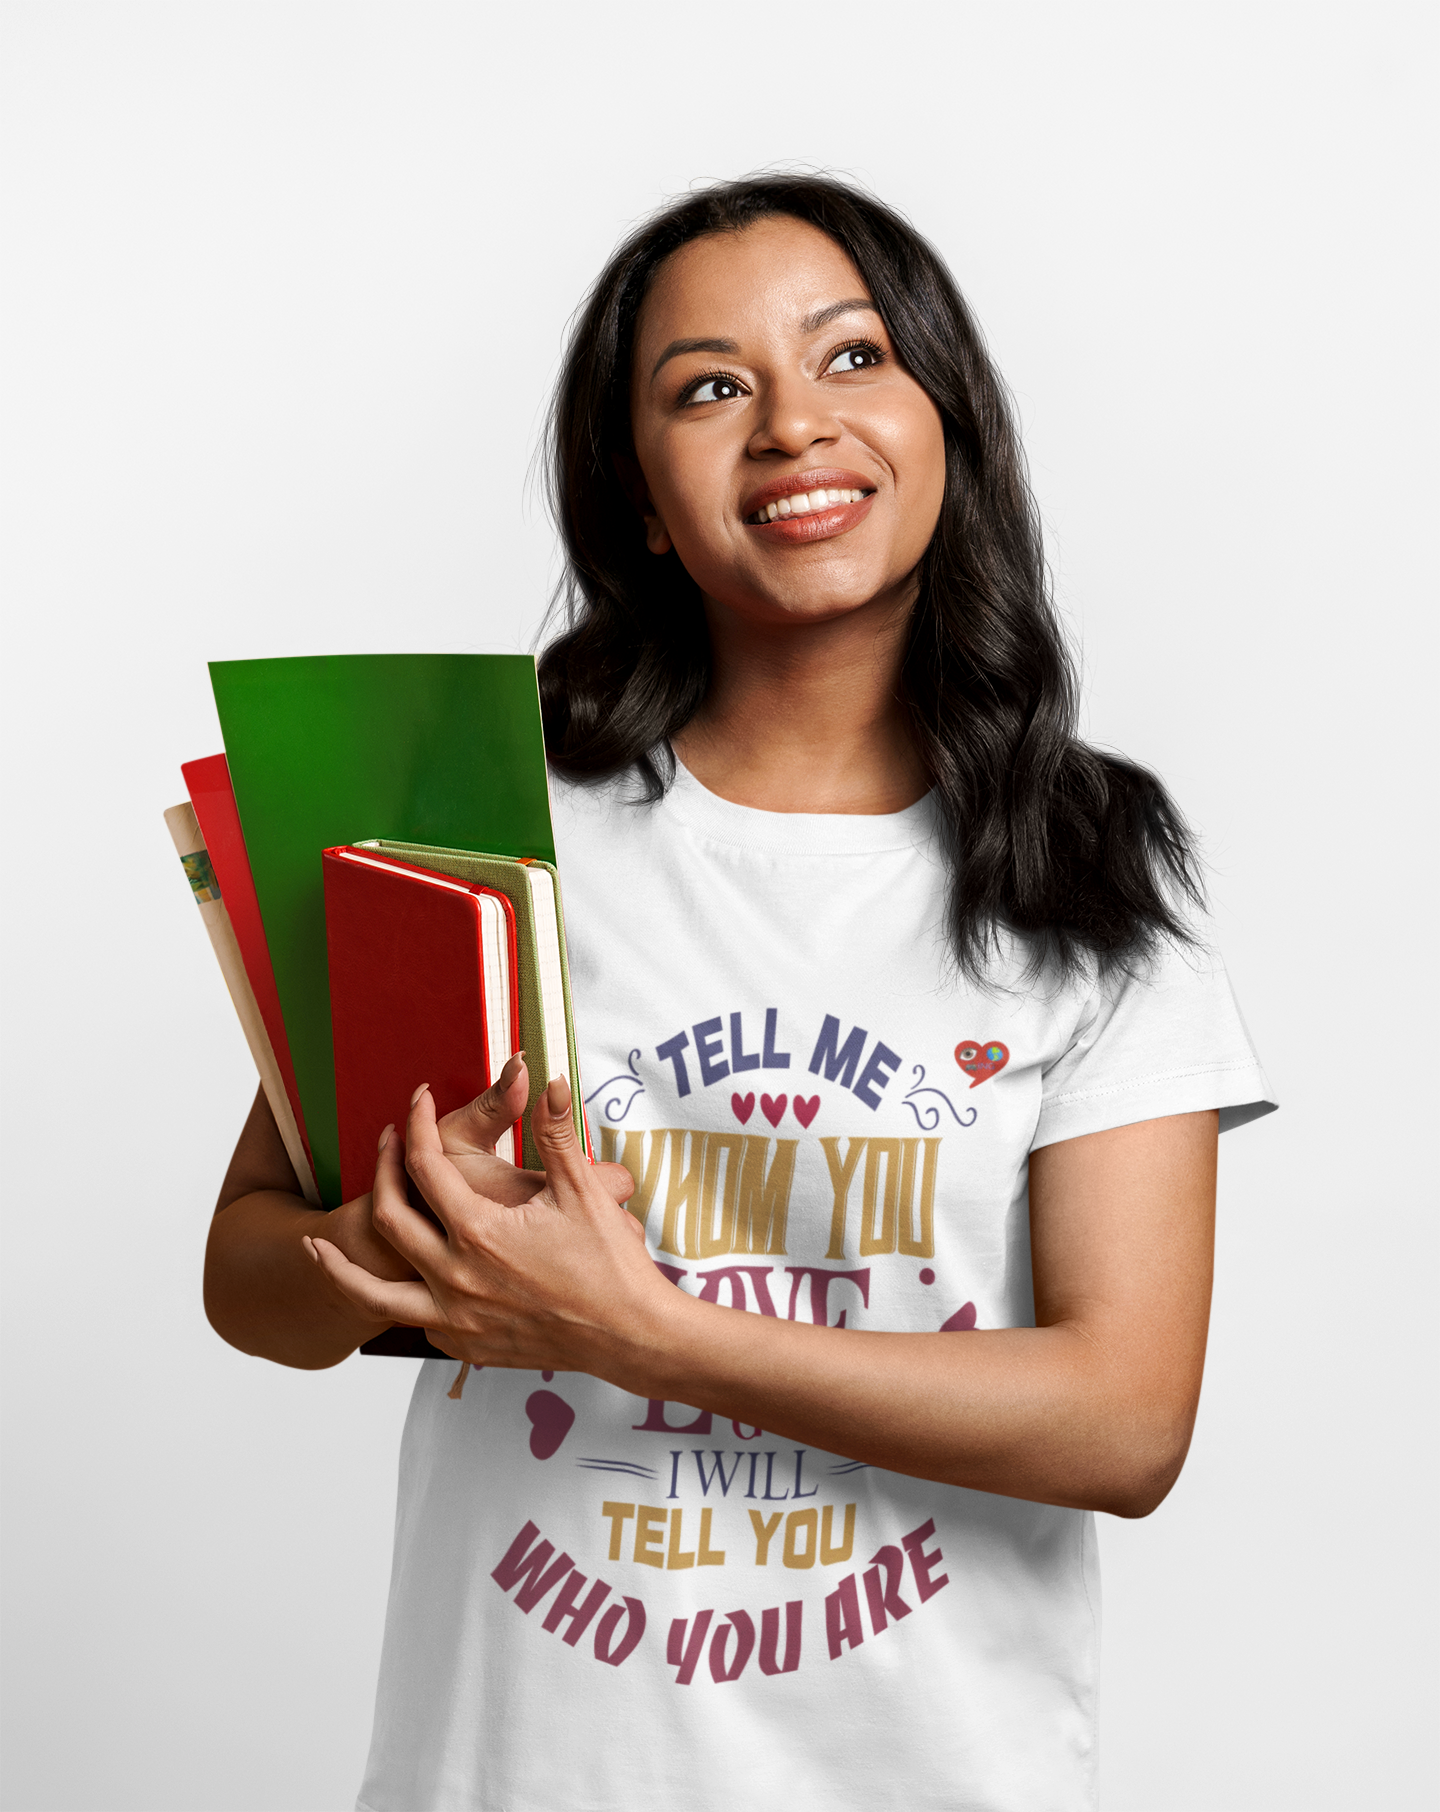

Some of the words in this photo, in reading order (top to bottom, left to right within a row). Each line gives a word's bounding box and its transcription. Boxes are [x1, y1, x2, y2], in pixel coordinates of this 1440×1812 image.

[655, 1008, 791, 1099] TELL
[807, 1013, 903, 1112] ME
[599, 1125, 800, 1261] WHOM
[819, 1136, 944, 1260] YOU
[666, 1450, 684, 1499] I
[691, 1449, 819, 1501] WILL
[601, 1500, 726, 1571] TELL
[747, 1502, 857, 1570] YOU
[490, 1519, 647, 1667] WHO
[666, 1600, 804, 1686] YOU
[824, 1517, 950, 1661] ARE
